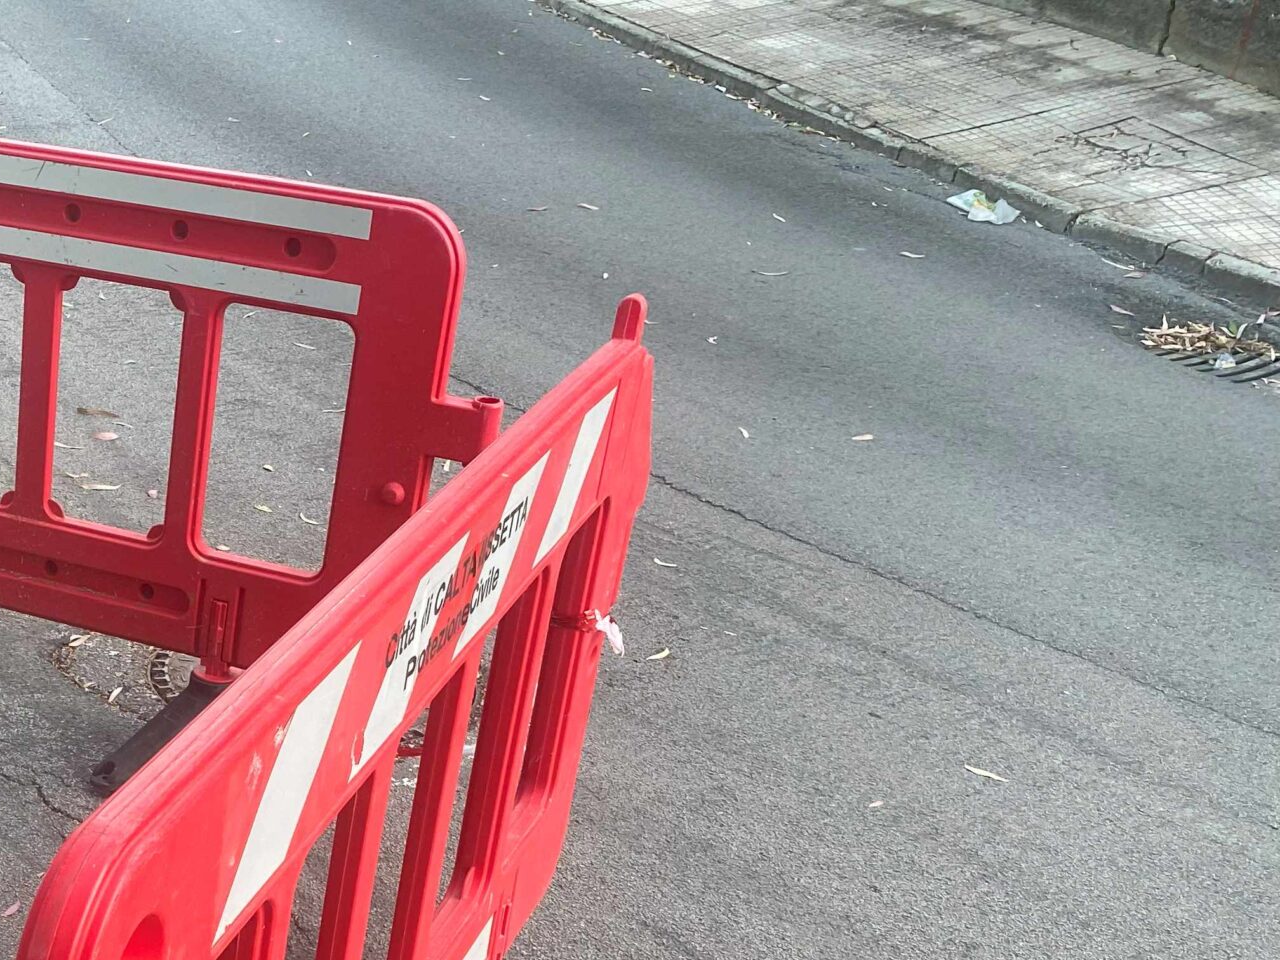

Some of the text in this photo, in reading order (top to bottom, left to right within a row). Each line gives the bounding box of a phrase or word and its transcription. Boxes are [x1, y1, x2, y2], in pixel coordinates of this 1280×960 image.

[385, 611, 417, 668] Città
[421, 594, 433, 632] di
[403, 603, 470, 690] Potezione
